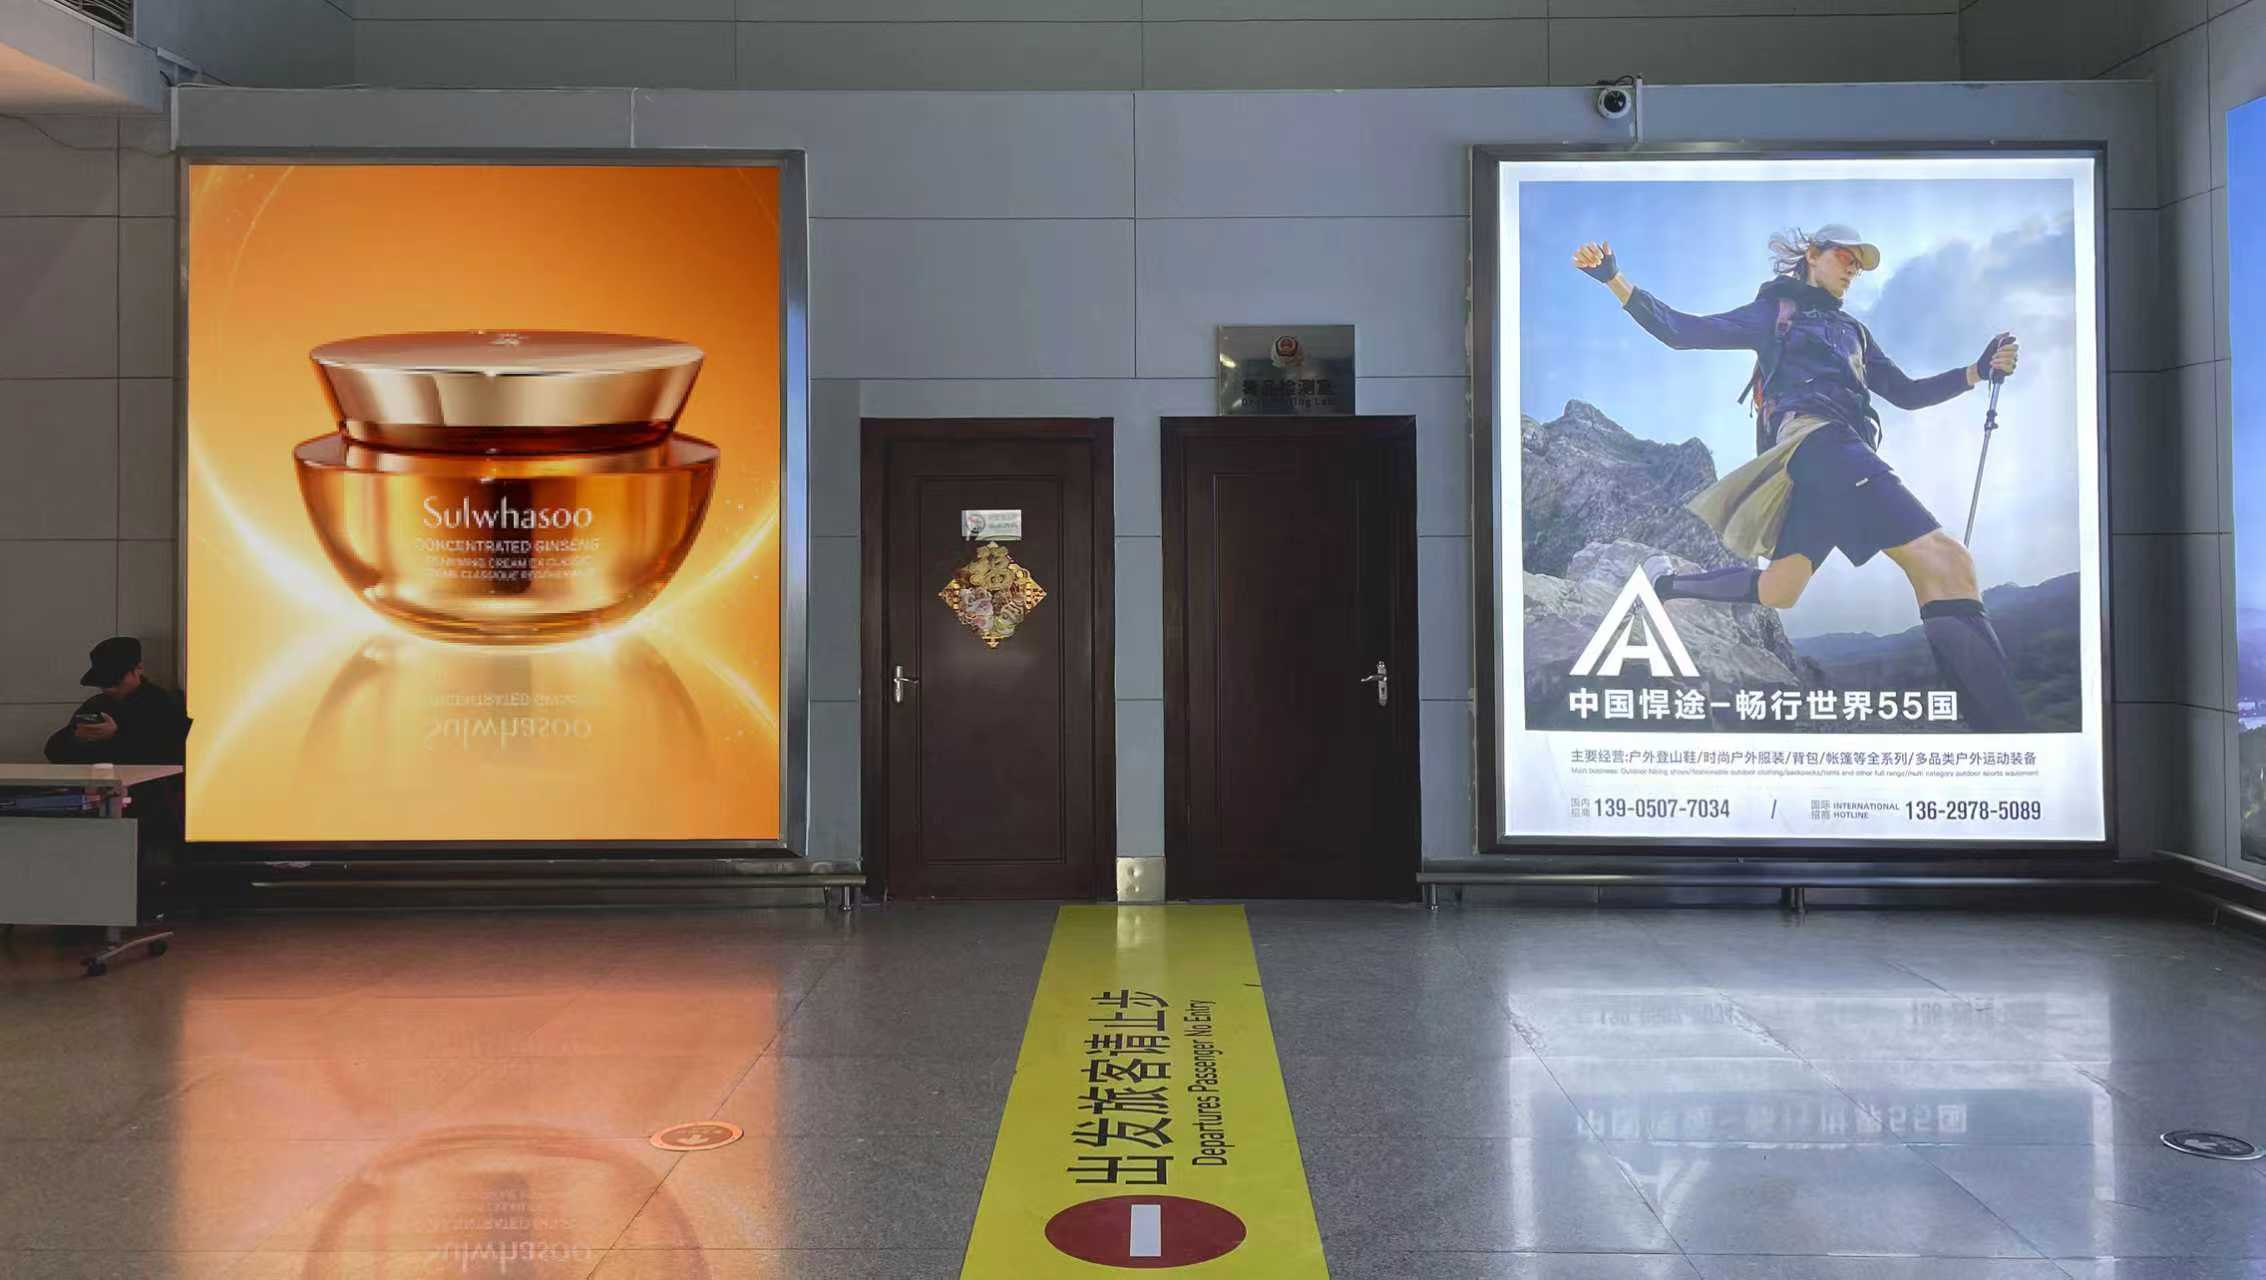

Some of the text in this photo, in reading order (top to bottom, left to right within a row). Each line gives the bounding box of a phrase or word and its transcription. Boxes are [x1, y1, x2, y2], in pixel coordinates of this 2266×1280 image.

[423, 496, 592, 528] Sulwhasoo
[1594, 797, 1730, 818] 139-0507-7034
[1833, 802, 1900, 811] INTERNATIONAL
[1833, 811, 1870, 820] HOTLINE
[1905, 800, 2041, 820] 136-2978-5089
[1066, 989, 1174, 1185] 出发旅客请止步
[1184, 999, 1236, 1166] Departures Passenger No Entry
